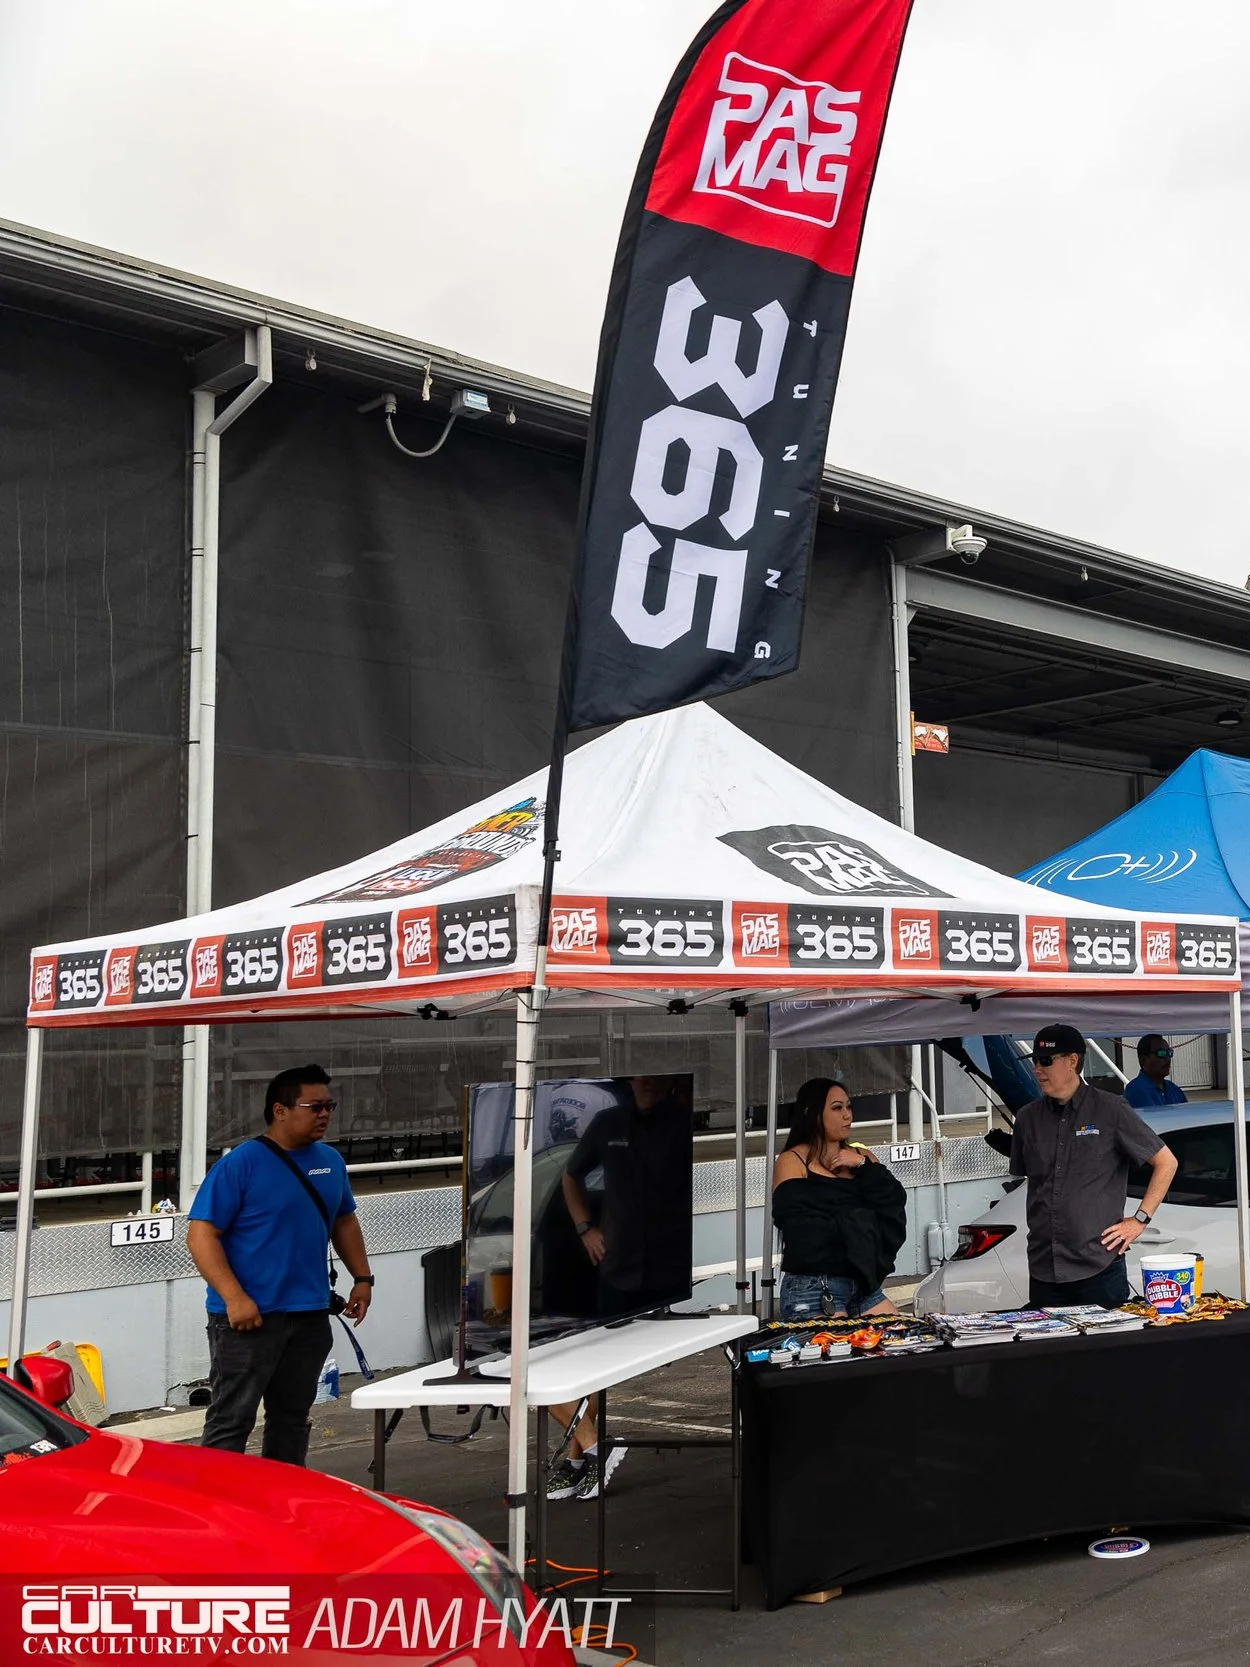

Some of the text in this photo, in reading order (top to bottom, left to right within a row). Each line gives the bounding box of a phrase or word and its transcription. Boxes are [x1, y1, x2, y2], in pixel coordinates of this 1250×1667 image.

[714, 80, 861, 148] PAS
[698, 138, 852, 195] MAG
[610, 275, 790, 653] 365
[754, 319, 818, 659] TUNING
[443, 907, 509, 920] TUNING
[551, 909, 598, 934] PAS
[618, 908, 713, 917] TUNING
[796, 914, 876, 923] TUNING
[945, 920, 1013, 929] TUNING
[327, 923, 385, 935] TUNING
[403, 917, 432, 944] PAS
[741, 914, 779, 937] PAS
[899, 920, 931, 944] PAS
[1072, 926, 1130, 934] TUNING
[1180, 931, 1231, 939] TUNING
[227, 937, 278, 948] TUNING
[443, 918, 512, 964] 365
[551, 929, 598, 950] MAG
[617, 919, 716, 958] 365
[741, 933, 780, 953] MAG
[796, 924, 879, 961] 365
[900, 938, 931, 960] MAG
[945, 929, 1016, 964] 365
[1072, 935, 1132, 966] 365
[326, 934, 387, 976] 365
[1180, 939, 1233, 968] 365
[137, 958, 185, 995] 365
[226, 947, 279, 986] 365
[59, 967, 101, 1002] 365
[896, 1146, 914, 1160] 147
[123, 1221, 161, 1242] 145
[1147, 1283, 1177, 1294] DUBBLE
[1149, 1290, 1179, 1302] BUBBLE
